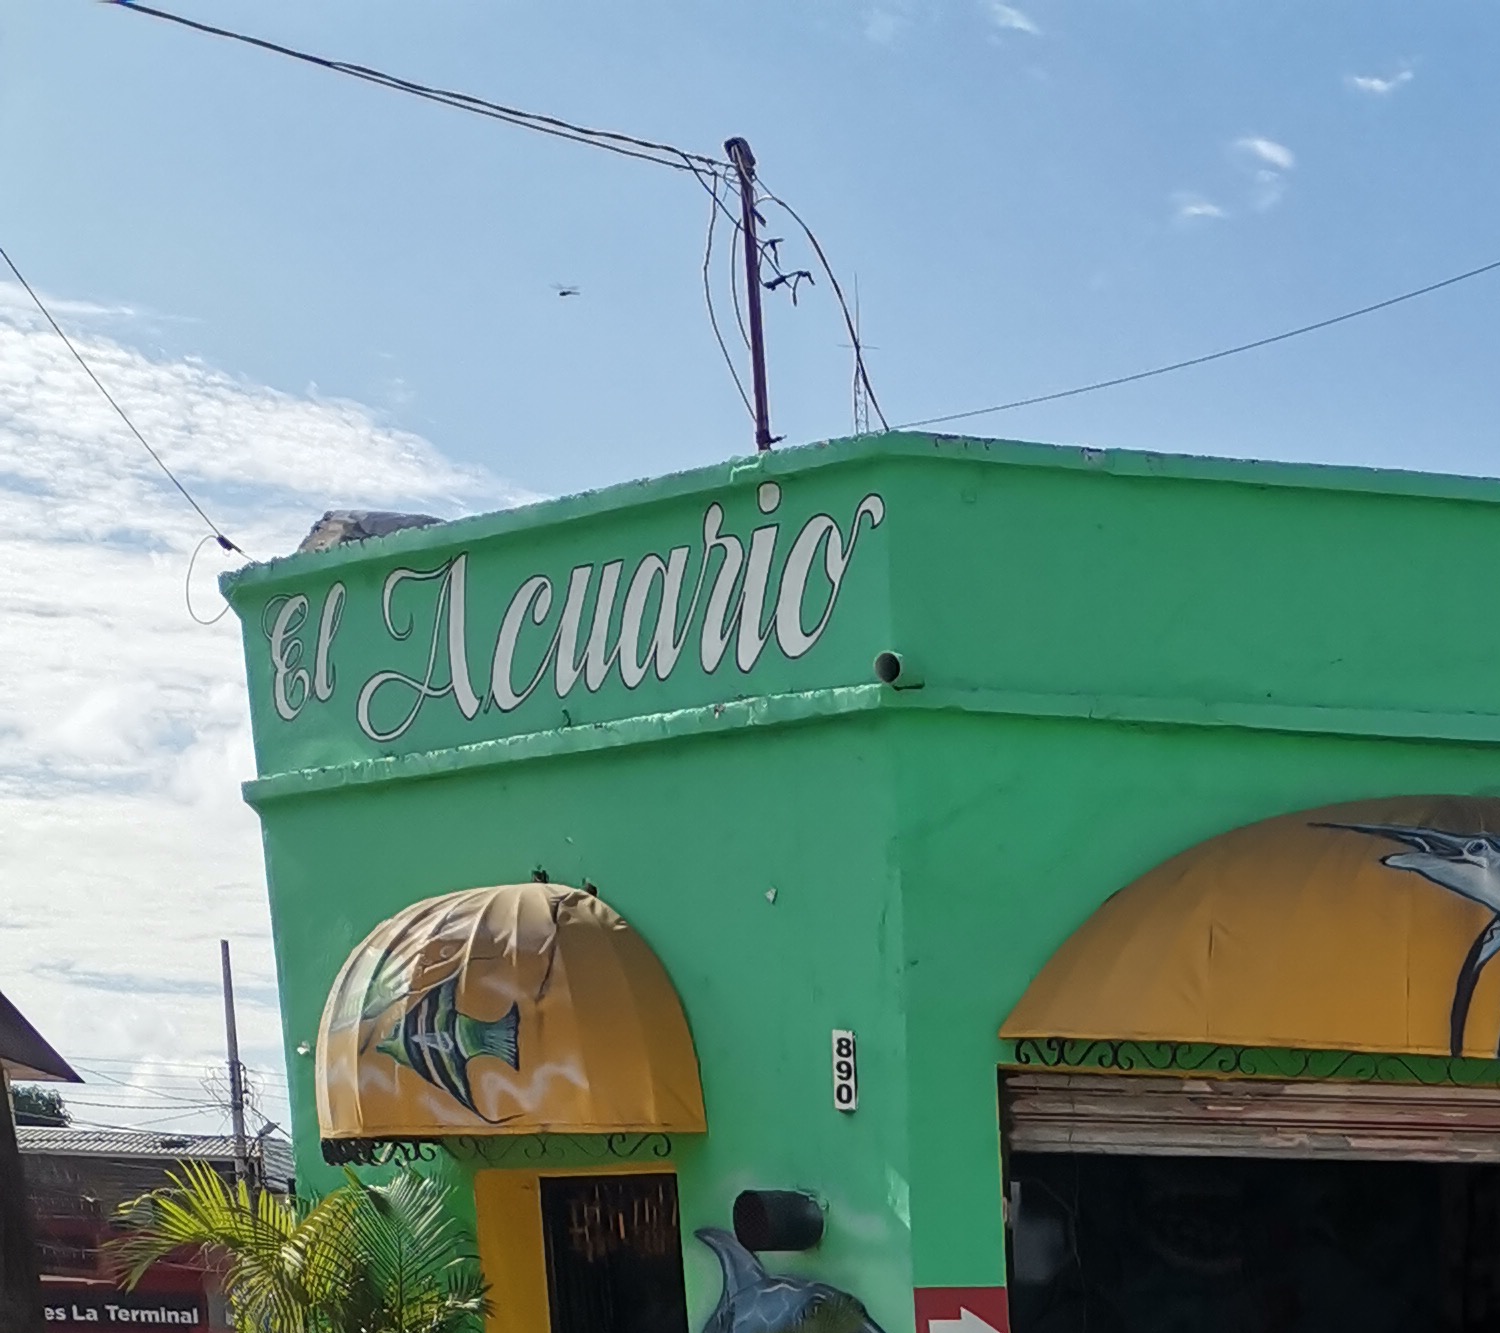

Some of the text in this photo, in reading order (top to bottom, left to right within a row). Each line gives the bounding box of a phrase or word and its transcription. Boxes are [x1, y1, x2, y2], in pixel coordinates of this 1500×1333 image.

[261, 479, 886, 744] El Acuario
[835, 1036, 853, 1105] 890
[71, 1304, 99, 1322] La
[104, 1304, 199, 1325] Terminal
